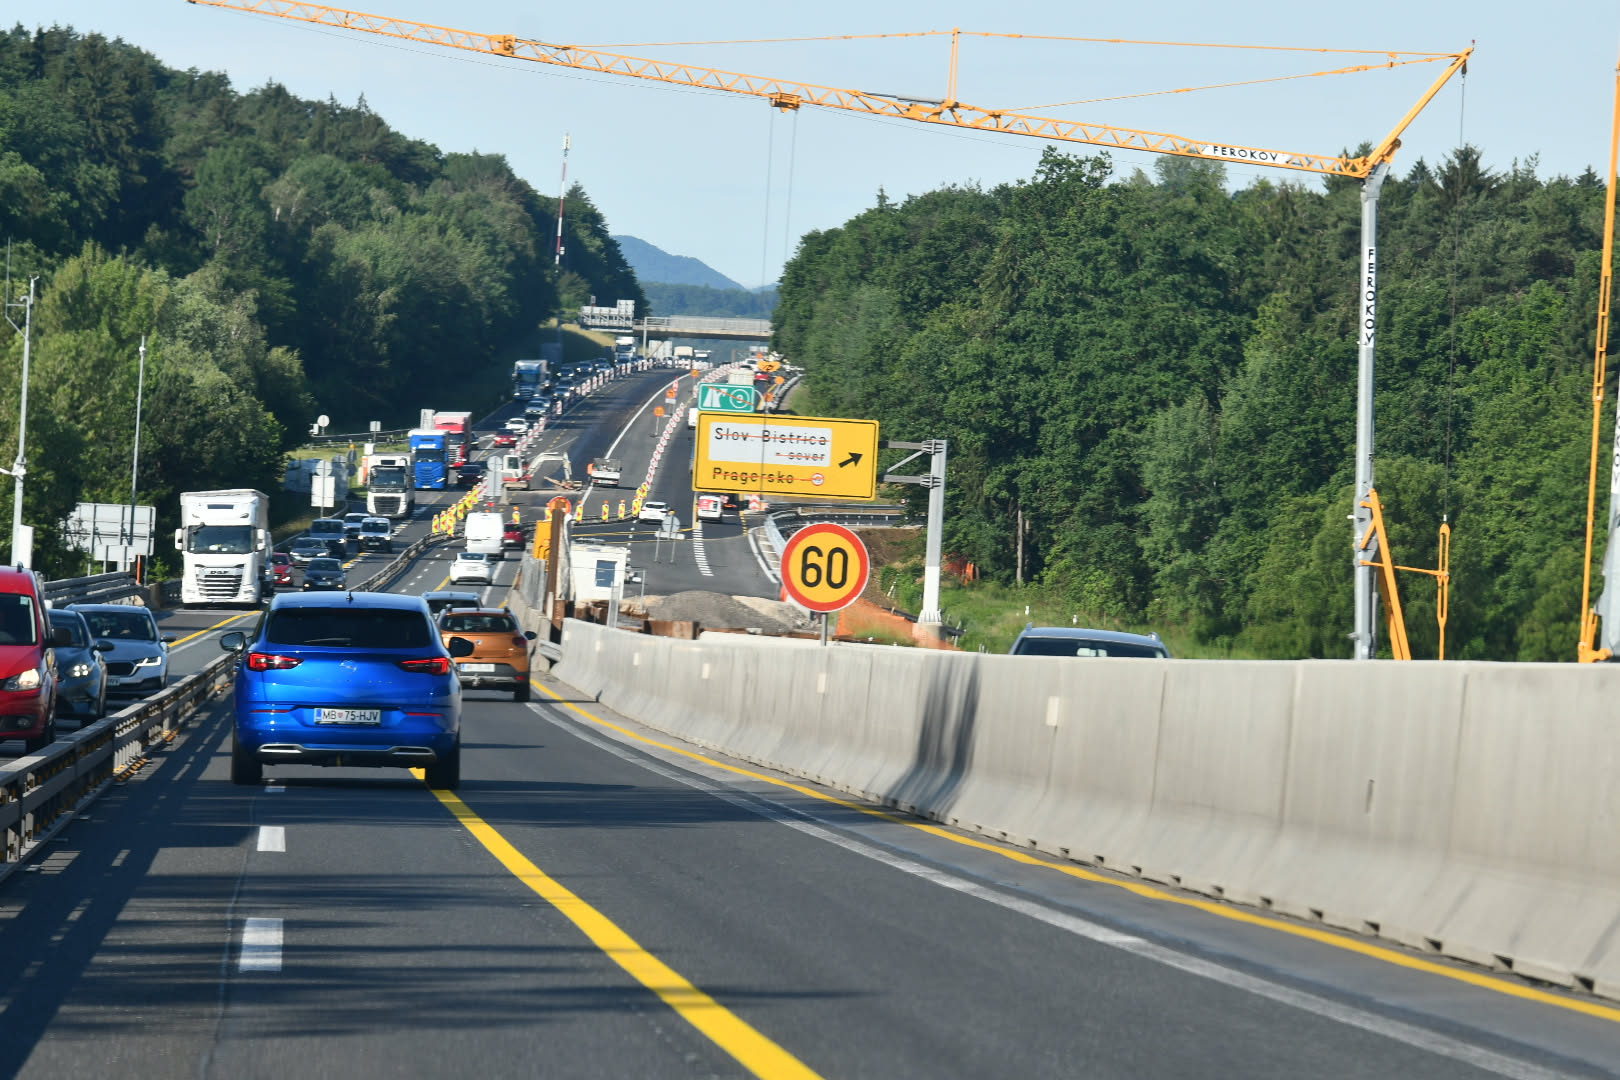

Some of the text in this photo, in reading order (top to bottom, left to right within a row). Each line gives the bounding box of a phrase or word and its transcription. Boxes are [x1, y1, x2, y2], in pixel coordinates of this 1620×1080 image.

[1213, 145, 1278, 161] FEROKOV
[1365, 248, 1376, 343] FEROKOV
[761, 429, 826, 446] Bistrica
[712, 467, 794, 485] Pragersko
[801, 545, 849, 590] 60
[322, 710, 379, 721] MB 75-HJV
